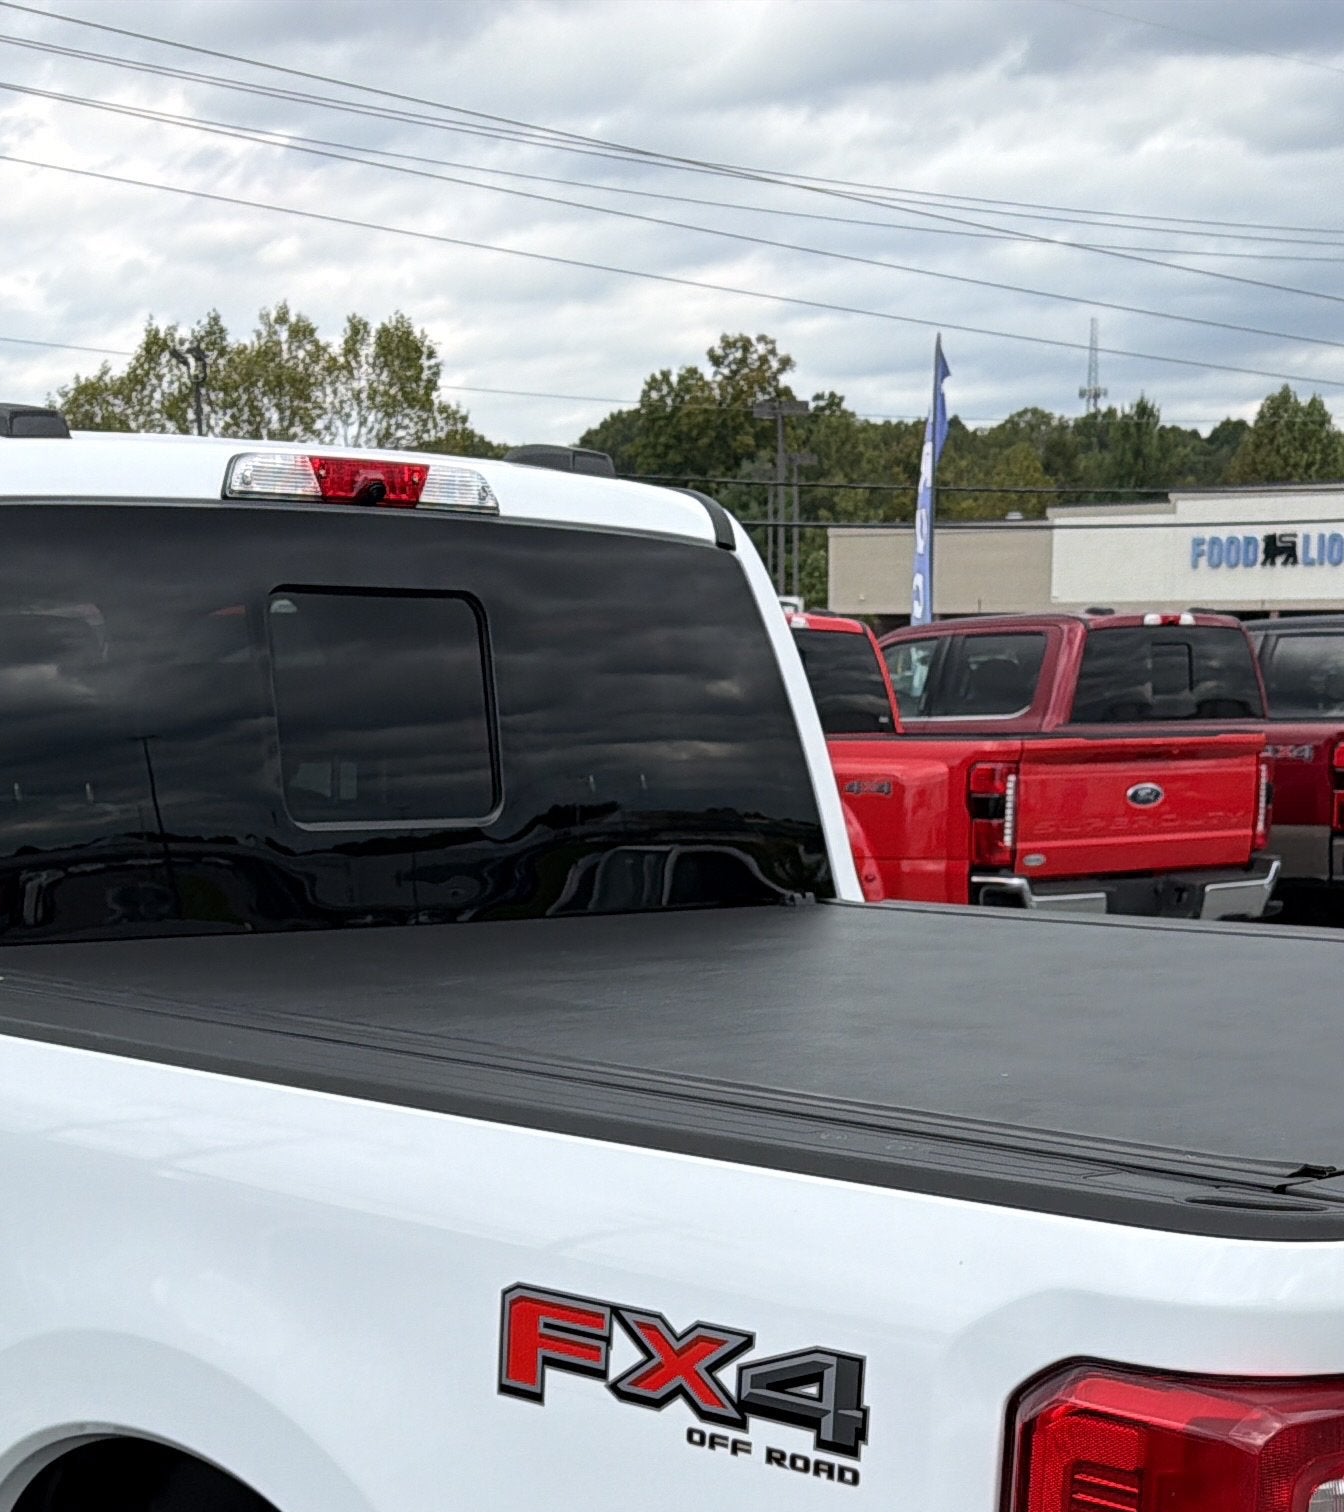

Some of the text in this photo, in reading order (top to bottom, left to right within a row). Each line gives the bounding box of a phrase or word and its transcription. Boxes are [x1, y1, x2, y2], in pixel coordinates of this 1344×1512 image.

[1191, 535, 1259, 569] FOOD
[497, 1282, 870, 1461] FX4
[686, 1426, 861, 1487] OFF ROAD
